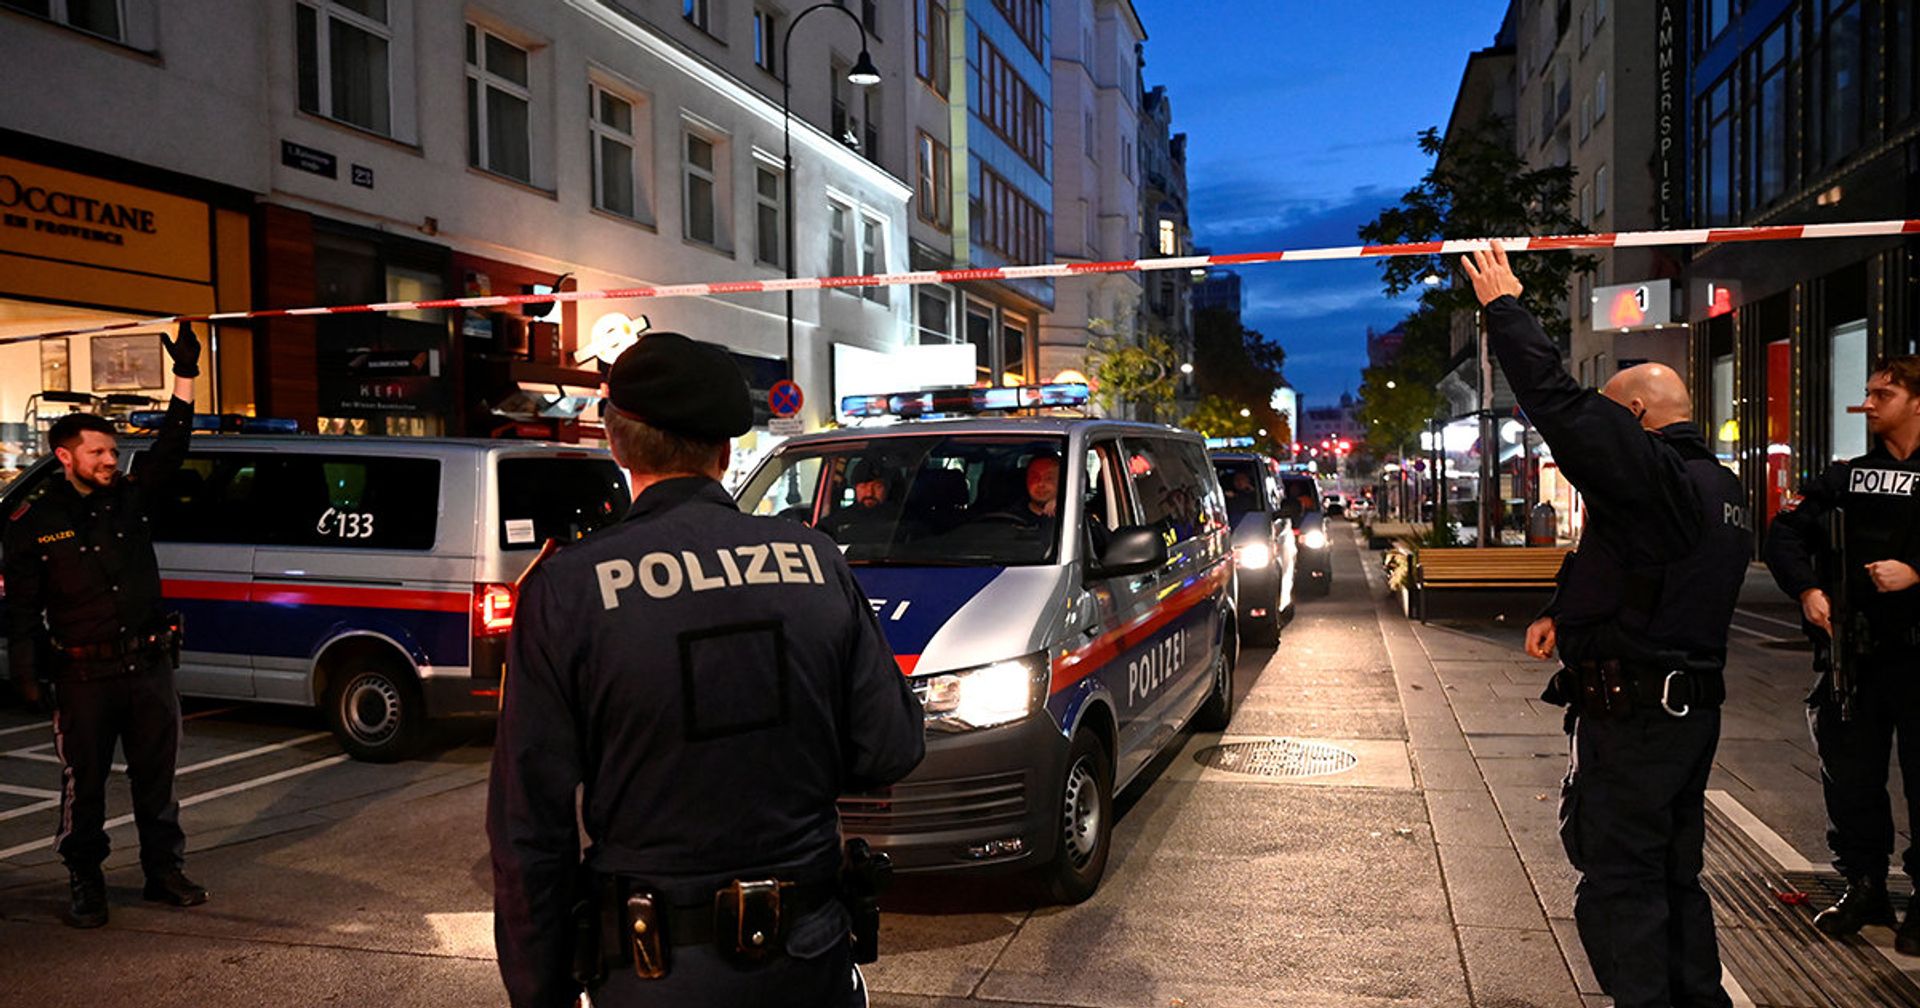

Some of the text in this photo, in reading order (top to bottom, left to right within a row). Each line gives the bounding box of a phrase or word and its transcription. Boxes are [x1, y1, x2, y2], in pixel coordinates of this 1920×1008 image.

[1658, 0, 1673, 229] AMMERSPIEL
[4, 213, 124, 246] EN PROVENCE
[337, 512, 374, 538] 133
[596, 542, 825, 611] POLIZEI
[1128, 628, 1186, 707] POLIZEI
